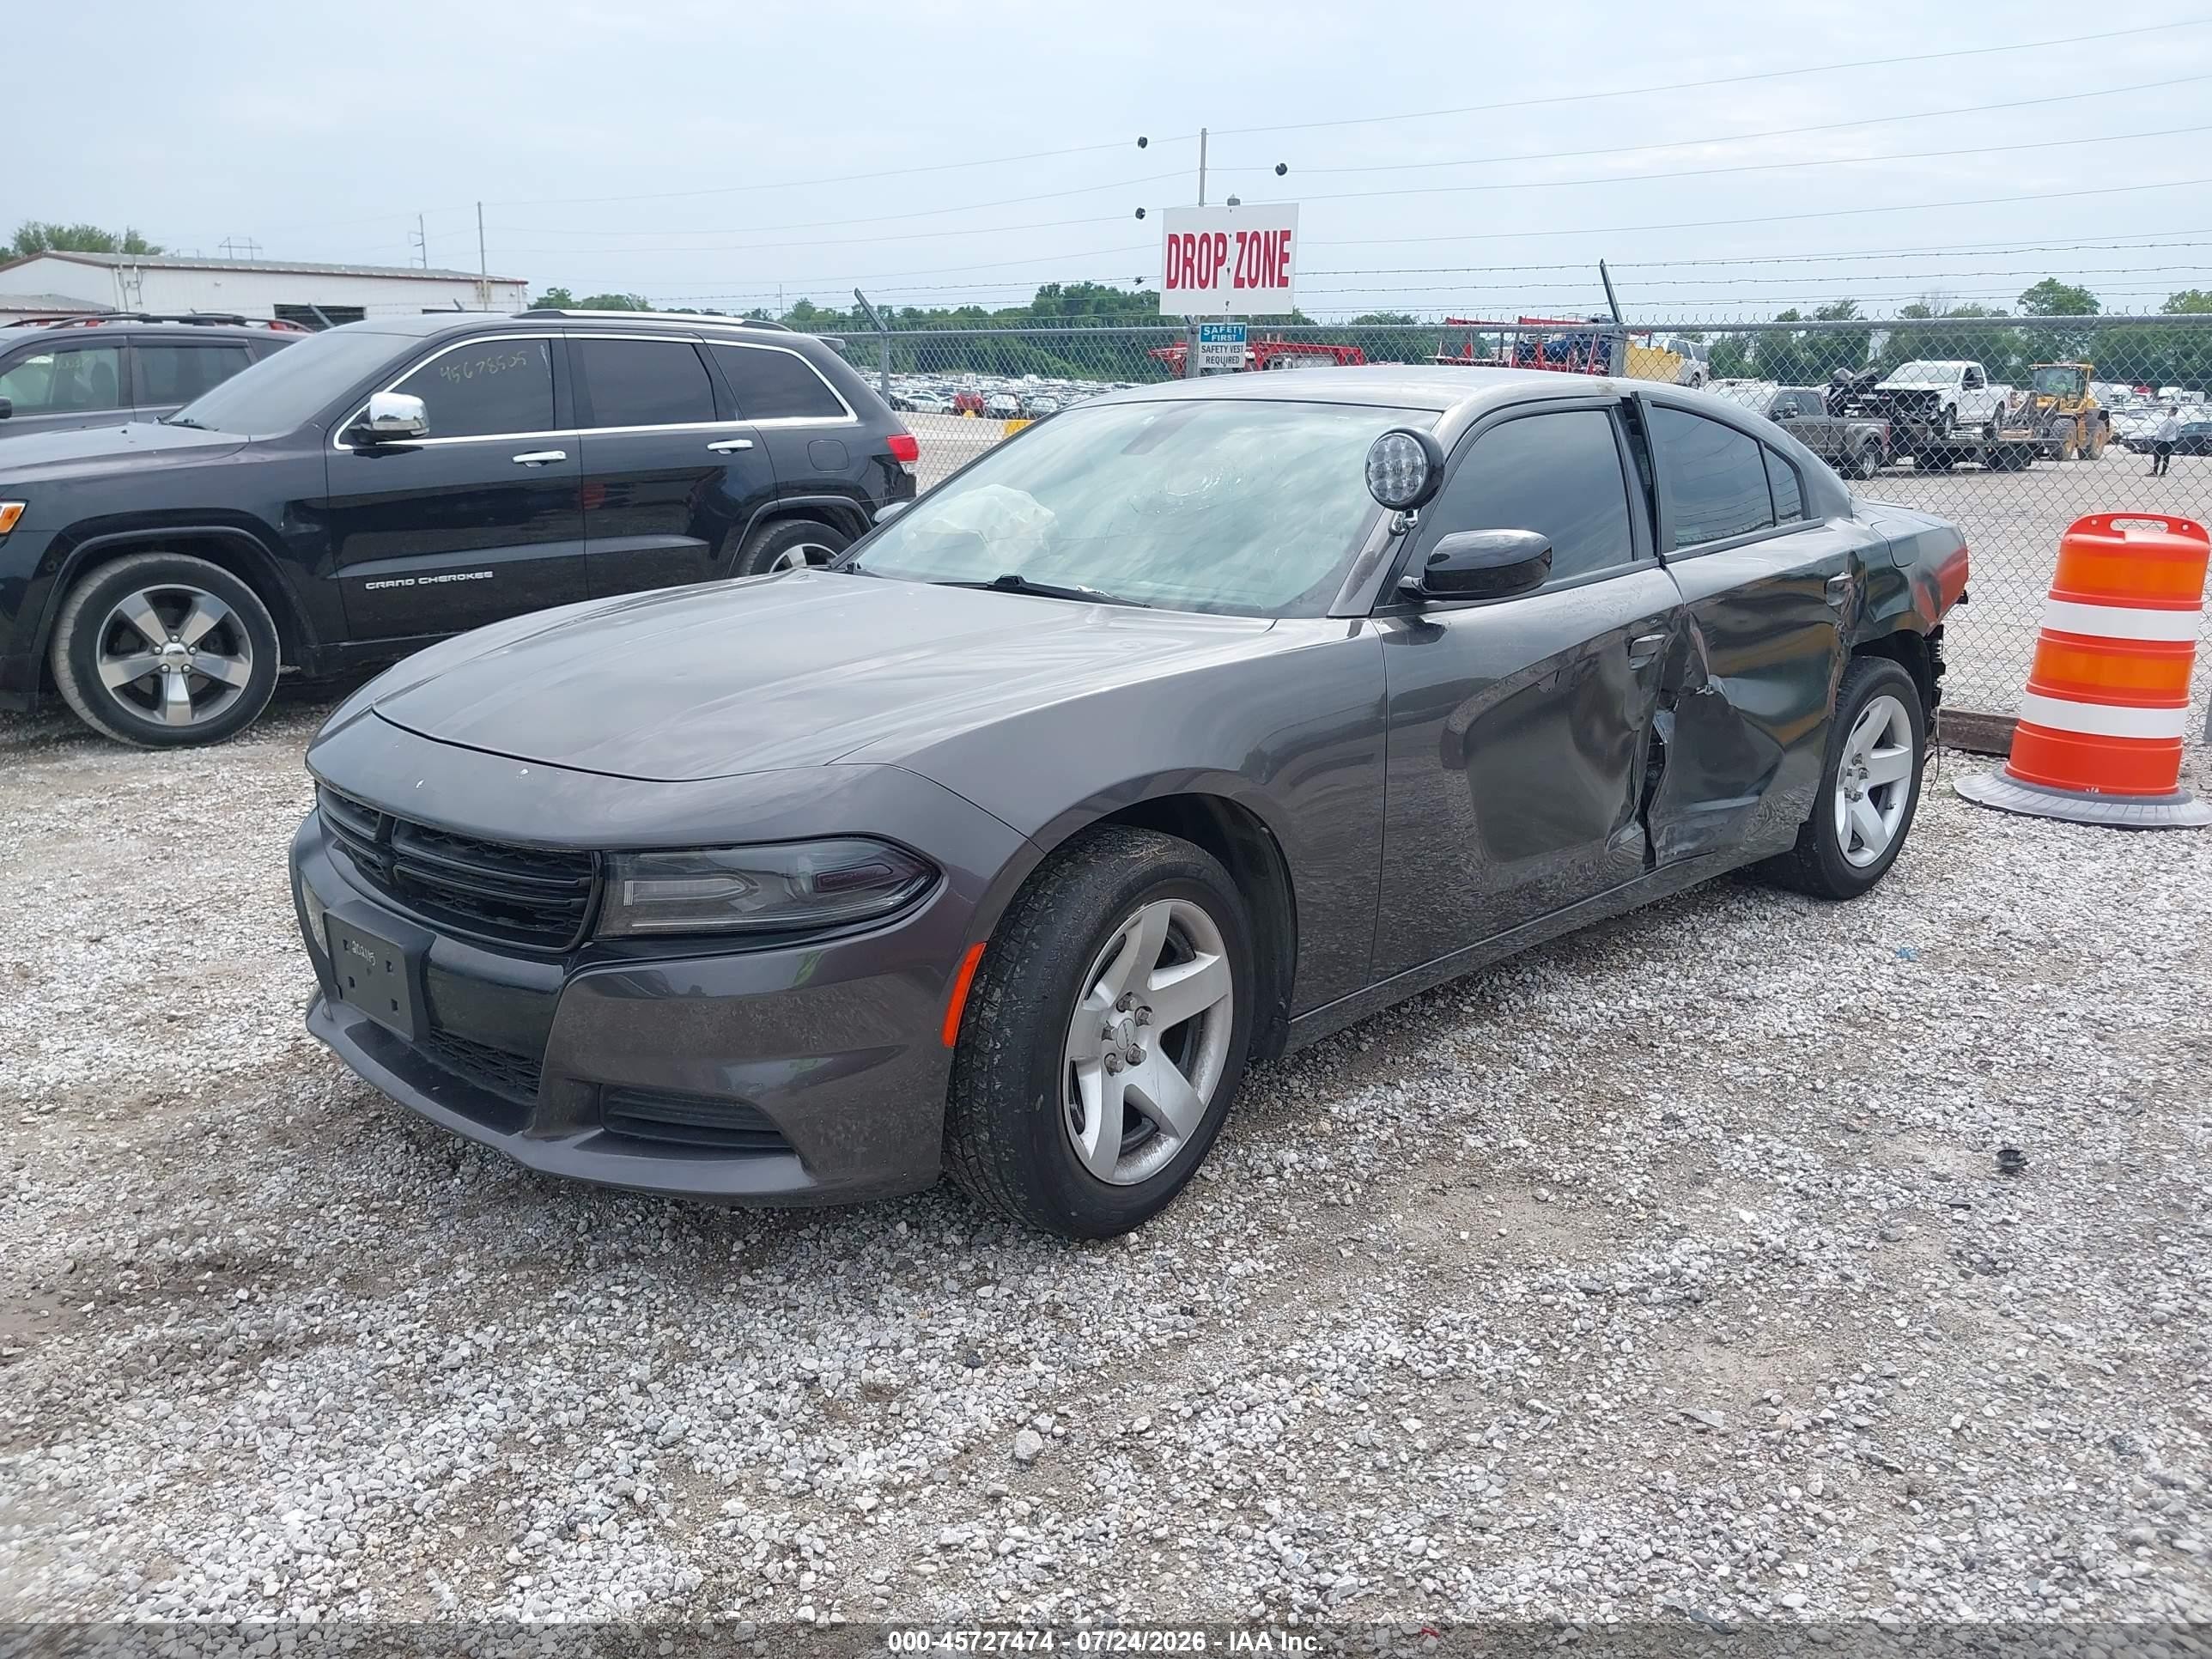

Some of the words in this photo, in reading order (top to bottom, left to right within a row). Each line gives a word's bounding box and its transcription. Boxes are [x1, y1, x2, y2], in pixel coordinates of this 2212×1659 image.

[1166, 232, 1227, 289] DROP
[1234, 230, 1291, 289] ZONE
[1203, 325, 1243, 336] SAFETY
[1201, 344, 1228, 354] SAFETY
[1230, 344, 1243, 354] VEST
[1206, 356, 1240, 365] REQUIRED
[365, 578, 415, 590] GRAND
[418, 571, 494, 585] CHEROKEE
